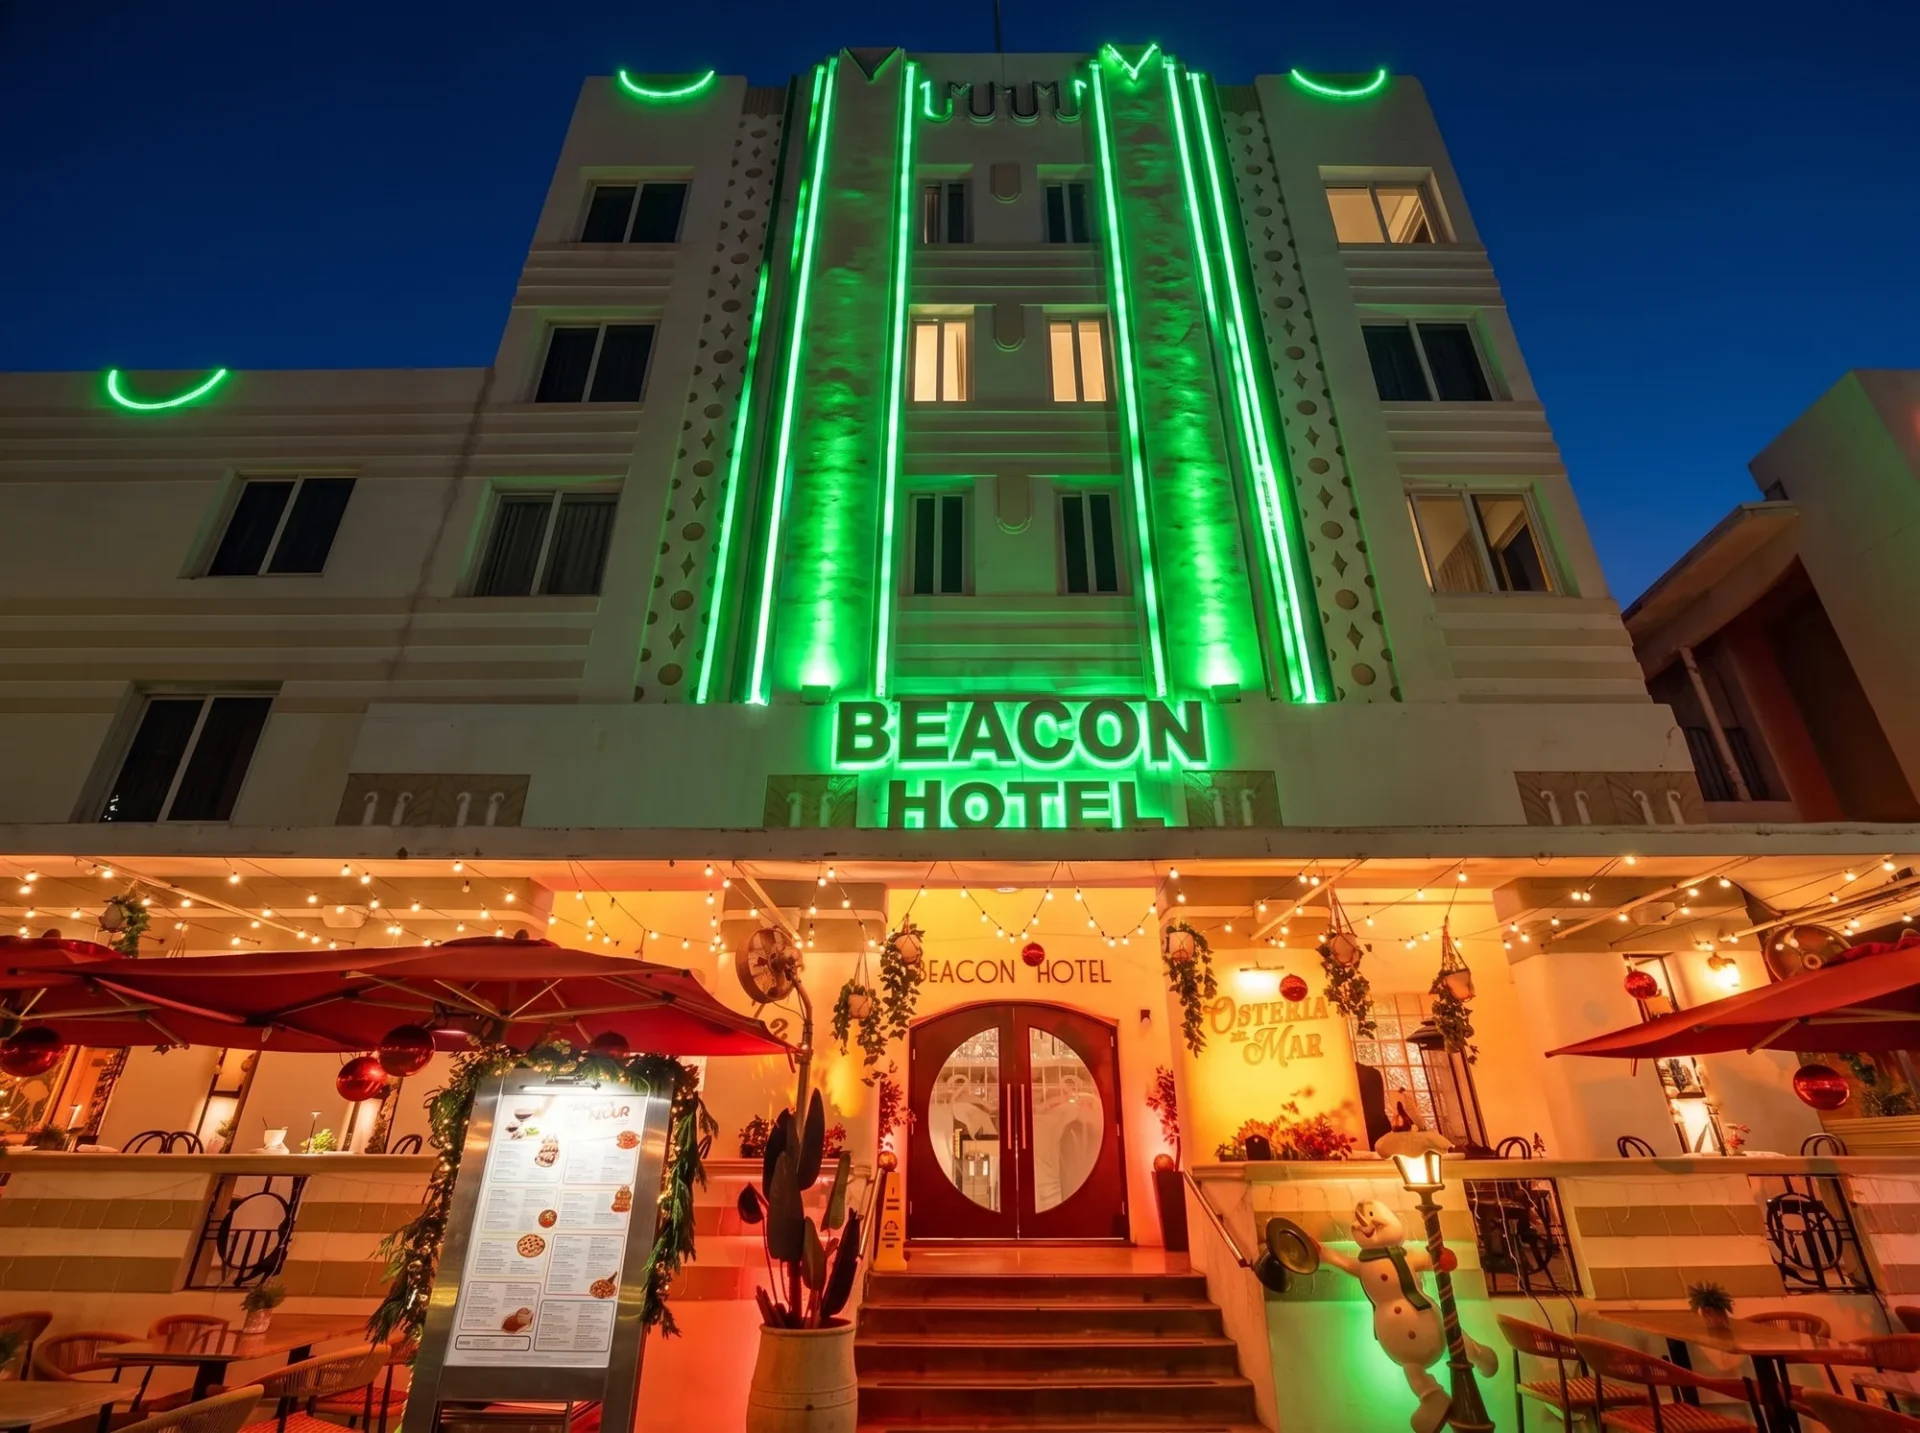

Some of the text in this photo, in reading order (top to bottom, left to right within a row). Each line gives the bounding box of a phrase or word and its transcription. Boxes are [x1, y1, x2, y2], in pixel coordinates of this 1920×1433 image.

[836, 699, 1208, 763] BEACON
[887, 779, 1165, 828] HOTEL
[1037, 959, 1112, 984] HOTEL
